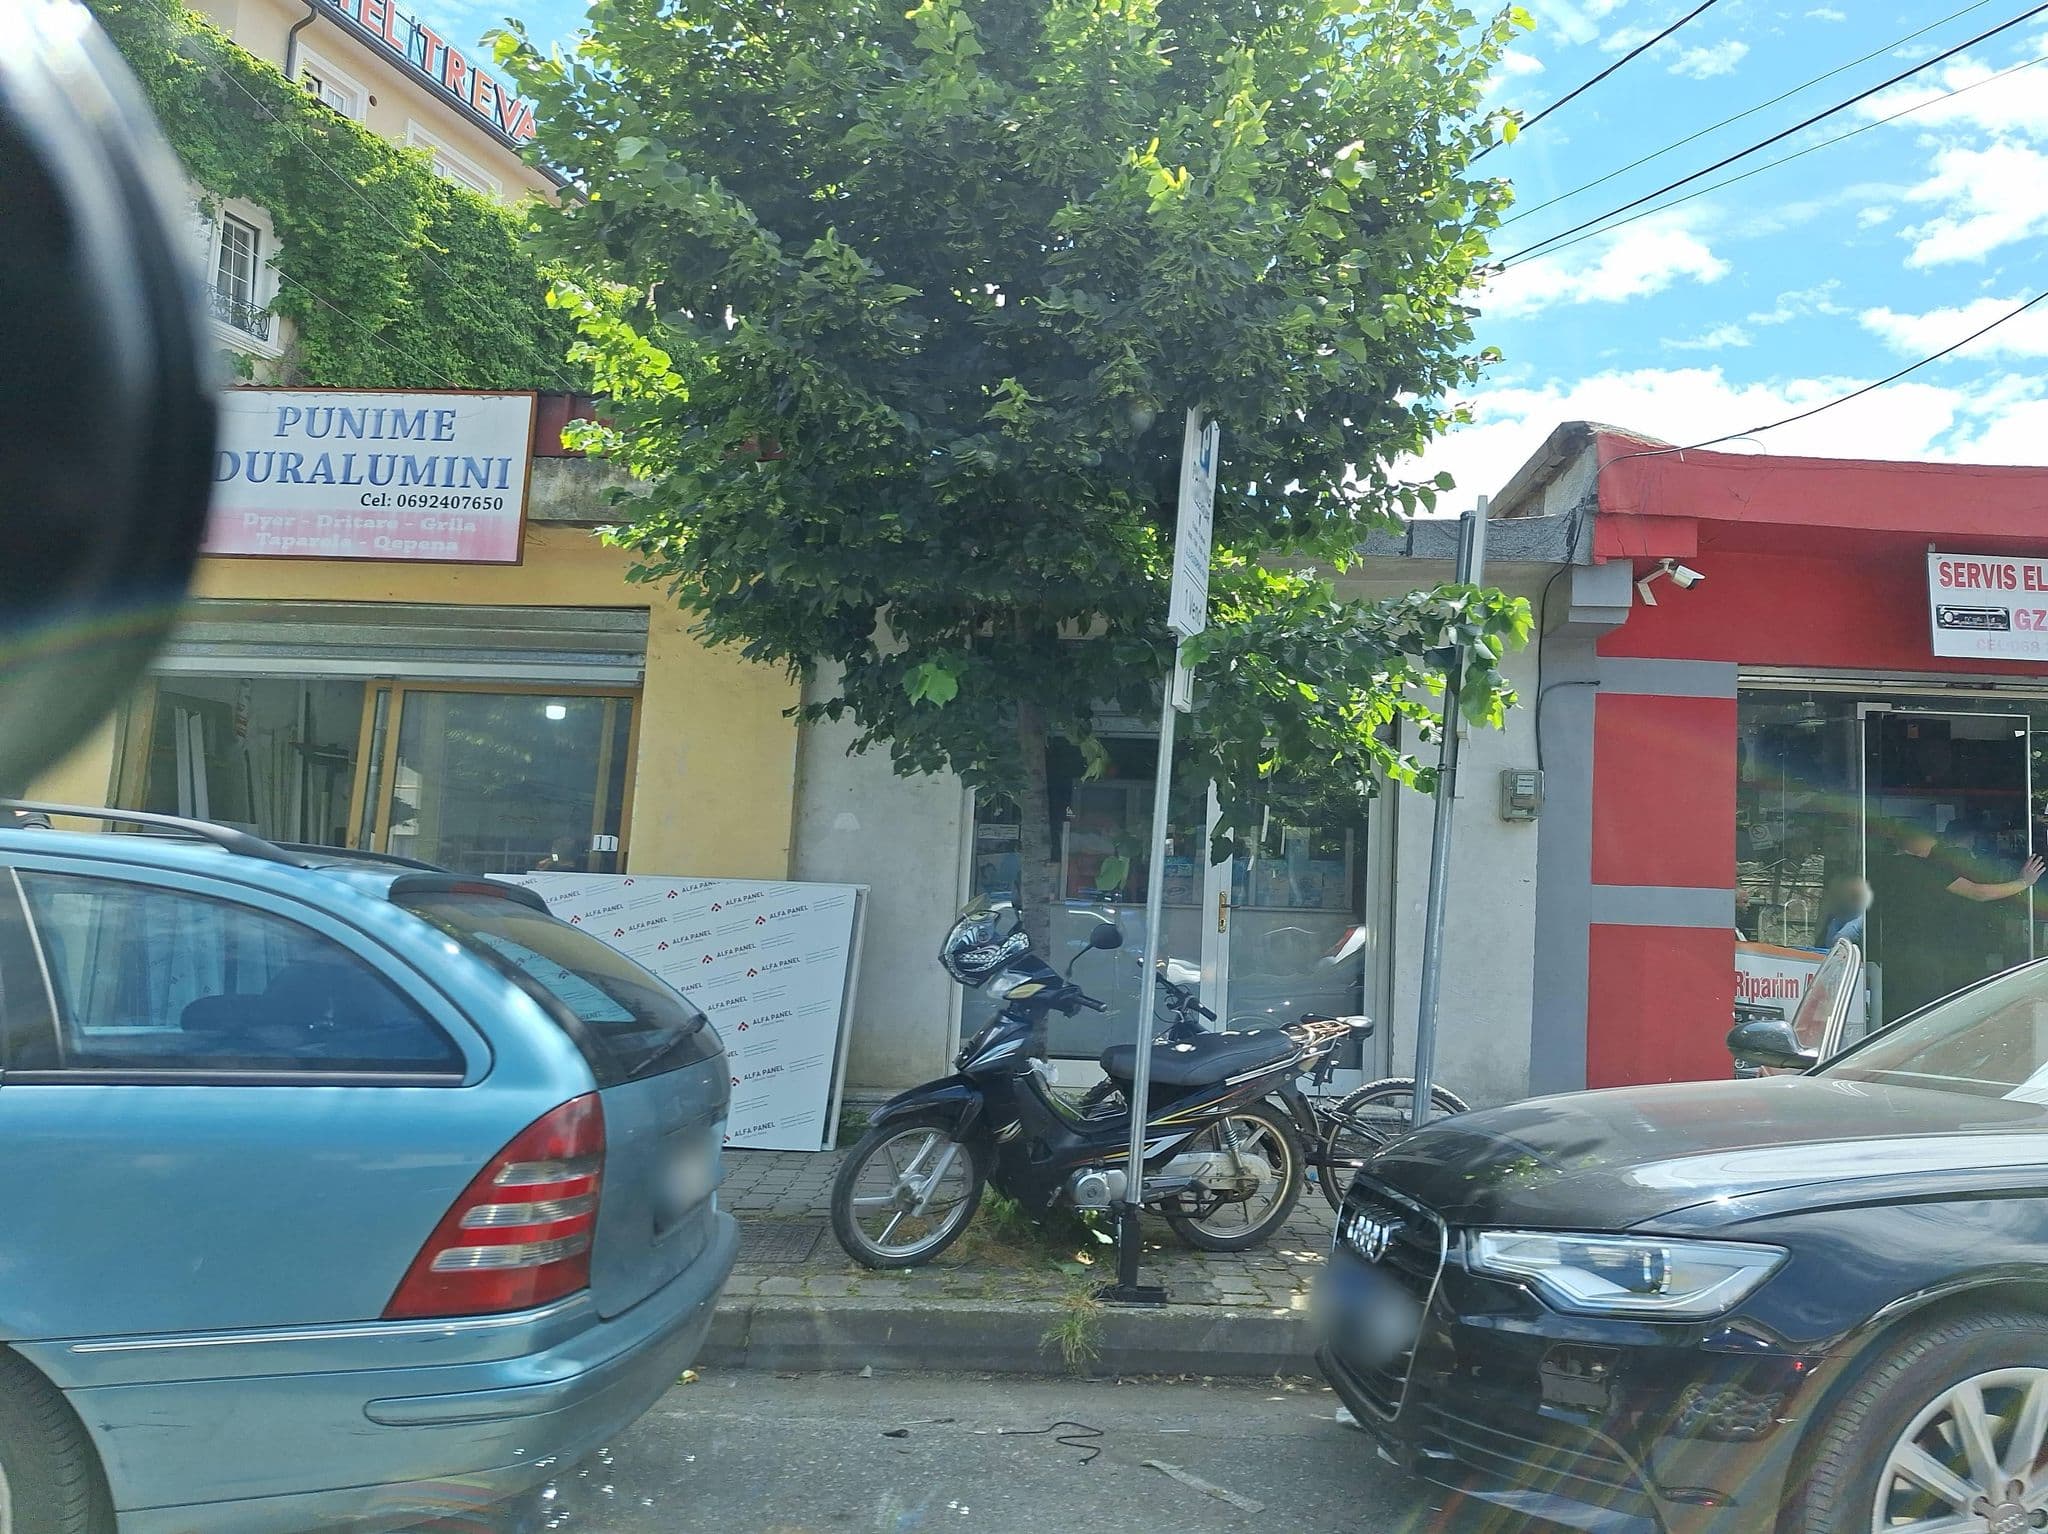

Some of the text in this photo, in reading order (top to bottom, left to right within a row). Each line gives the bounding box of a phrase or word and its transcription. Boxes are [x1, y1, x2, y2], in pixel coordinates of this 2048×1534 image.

[341, 0, 404, 52] EL
[273, 405, 457, 442] PUNIME
[213, 450, 512, 489] DURALUMINI
[360, 492, 504, 511] Cel: 0692407650
[1939, 561, 2048, 591] SERVIS EL
[560, 890, 581, 900] PANEL
[682, 883, 699, 893] ALFA
[725, 896, 743, 906] ALFA
[743, 891, 765, 902] PANEL
[585, 904, 624, 918] ALFA PANEL
[769, 910, 786, 919] ALFA
[787, 905, 809, 915] PANEL
[628, 916, 668, 931] ALFA PANEL
[672, 929, 712, 945] ALFA PANEL
[716, 943, 757, 958] ALFA PANEL
[761, 957, 801, 971] ALFA PANEL
[681, 982, 703, 992] PANEL
[1735, 970, 1799, 1003] Riparim
[707, 996, 748, 1011] ALFA PANEL
[752, 1010, 793, 1025] ALFA PANEL
[744, 1065, 785, 1080] ALFA PANEL
[734, 1121, 776, 1137] ALFA PANEL
